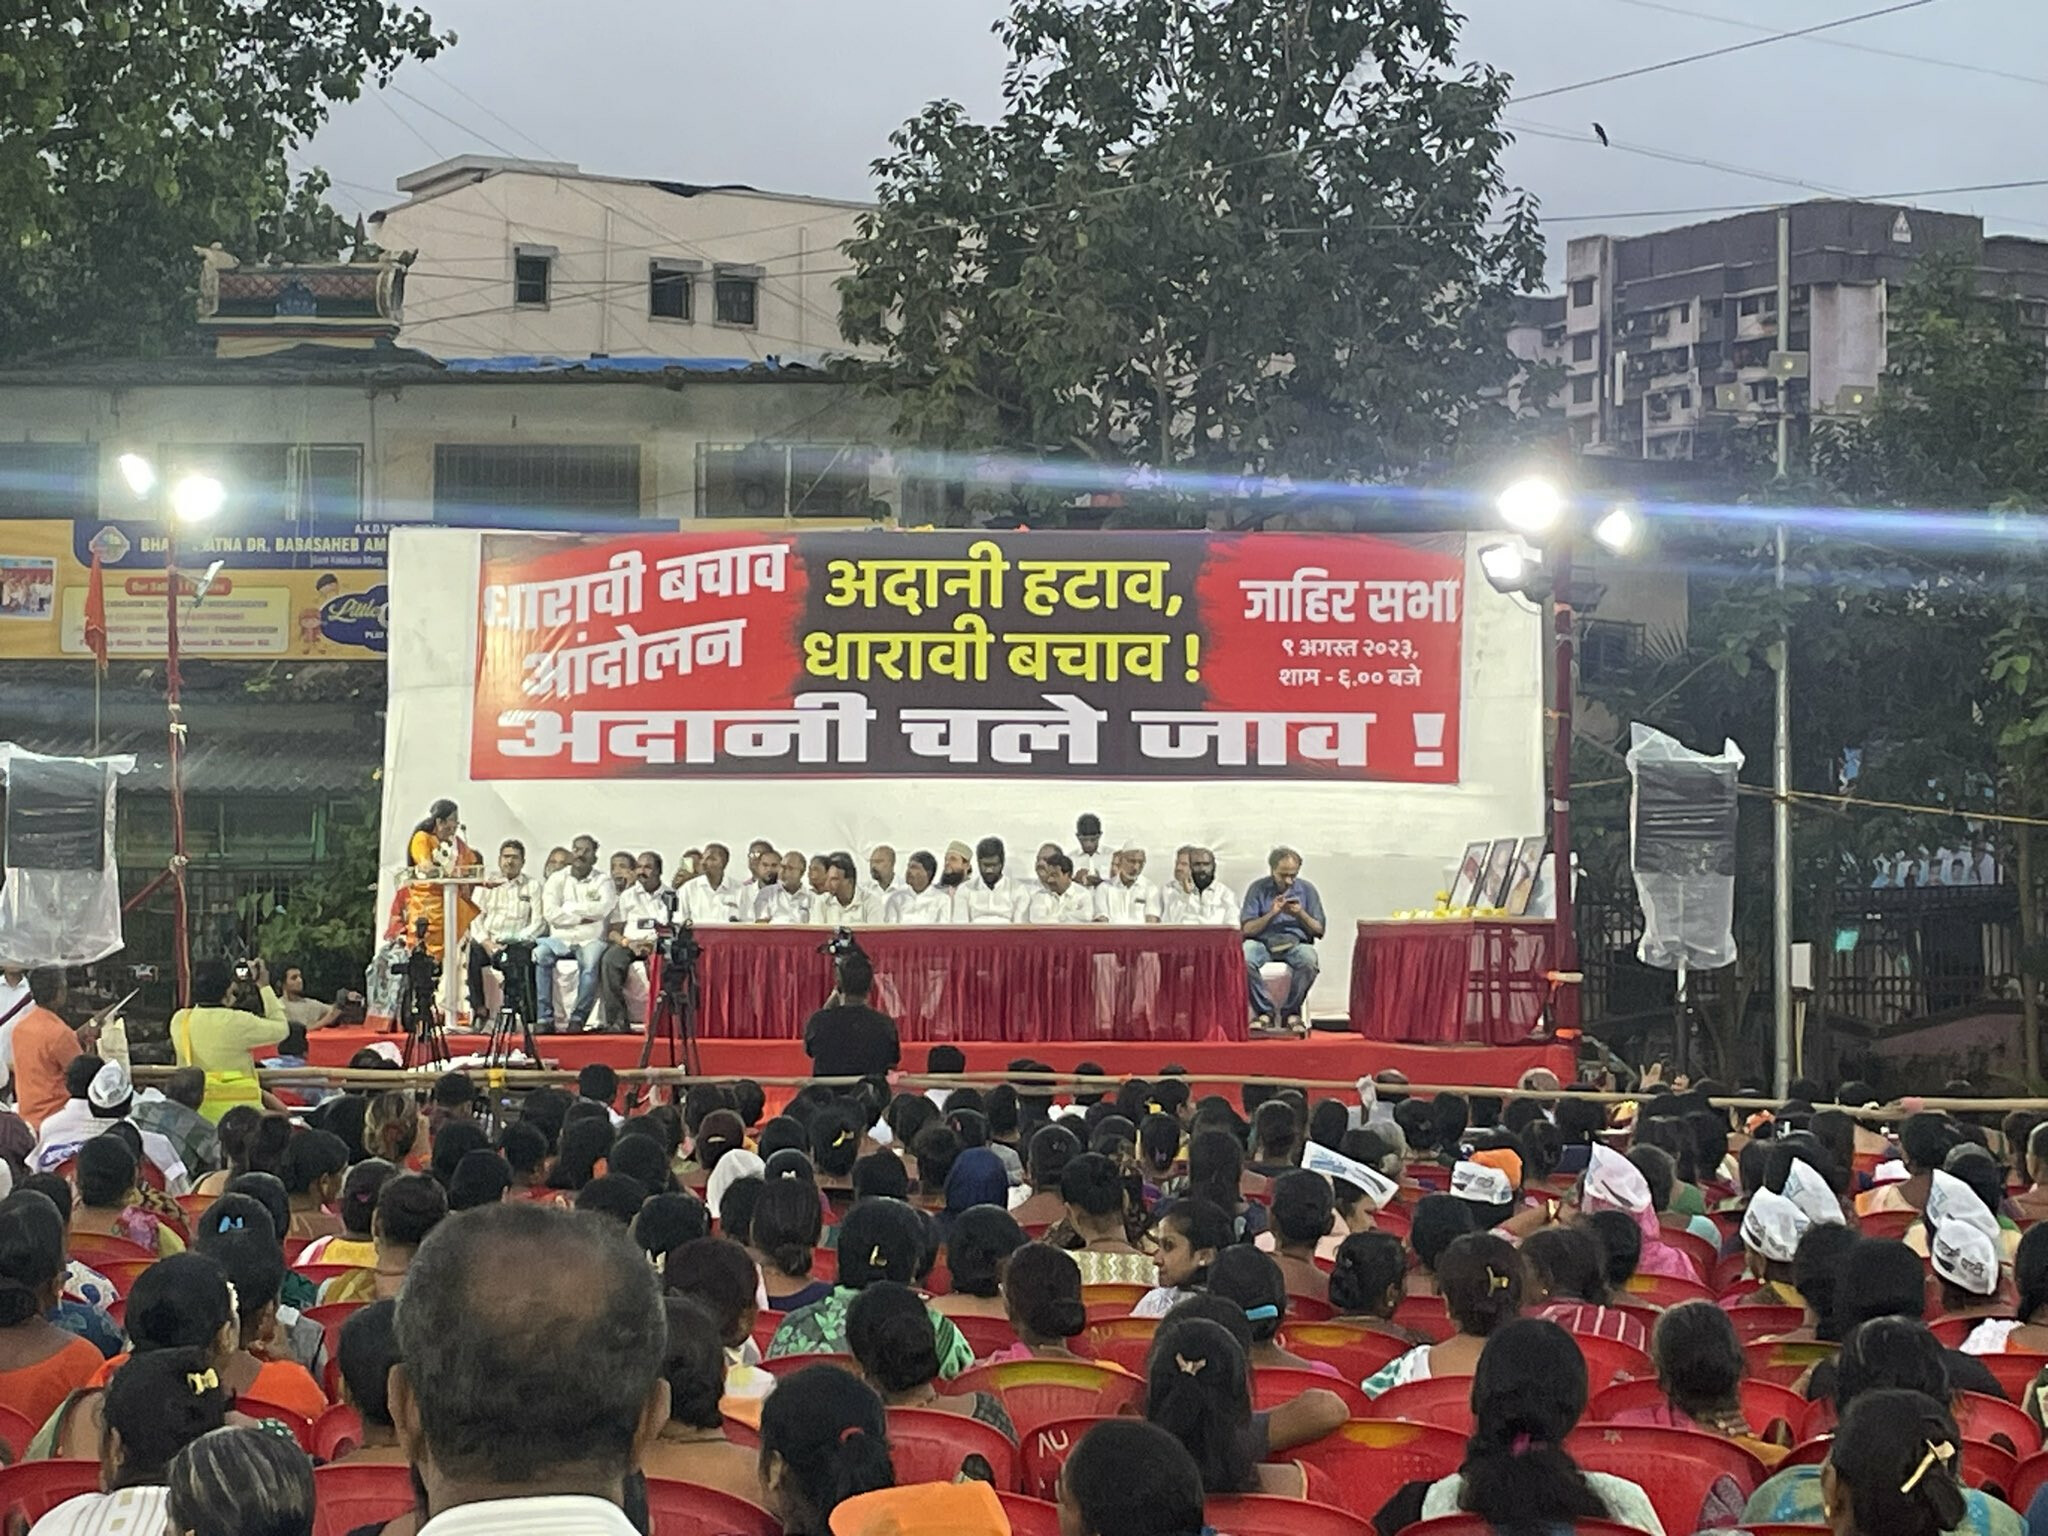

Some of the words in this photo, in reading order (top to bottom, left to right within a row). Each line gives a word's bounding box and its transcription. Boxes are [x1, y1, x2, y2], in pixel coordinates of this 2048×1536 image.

[276, 537, 359, 552] BABASAHEB
[824, 541, 1009, 615] अदानी
[1018, 560, 1184, 617] हटाव,
[483, 550, 646, 630] धारावी
[656, 544, 790, 603] बचाव
[1239, 567, 1359, 622] जाहिर
[1365, 580, 1459, 622] सभा
[522, 618, 747, 698] आंदोलन
[803, 614, 995, 682] धारावी
[1004, 633, 1171, 683] बचाव
[1184, 634, 1201, 683] !
[1278, 668, 1320, 686] शाम
[1388, 663, 1423, 686] बजे
[1299, 638, 1359, 657] अगस्त
[1363, 640, 1419, 659] २०२३,
[497, 691, 876, 764] अदानी
[900, 694, 1108, 764] चले
[1131, 711, 1376, 767] जाव
[1411, 713, 1447, 767] !
